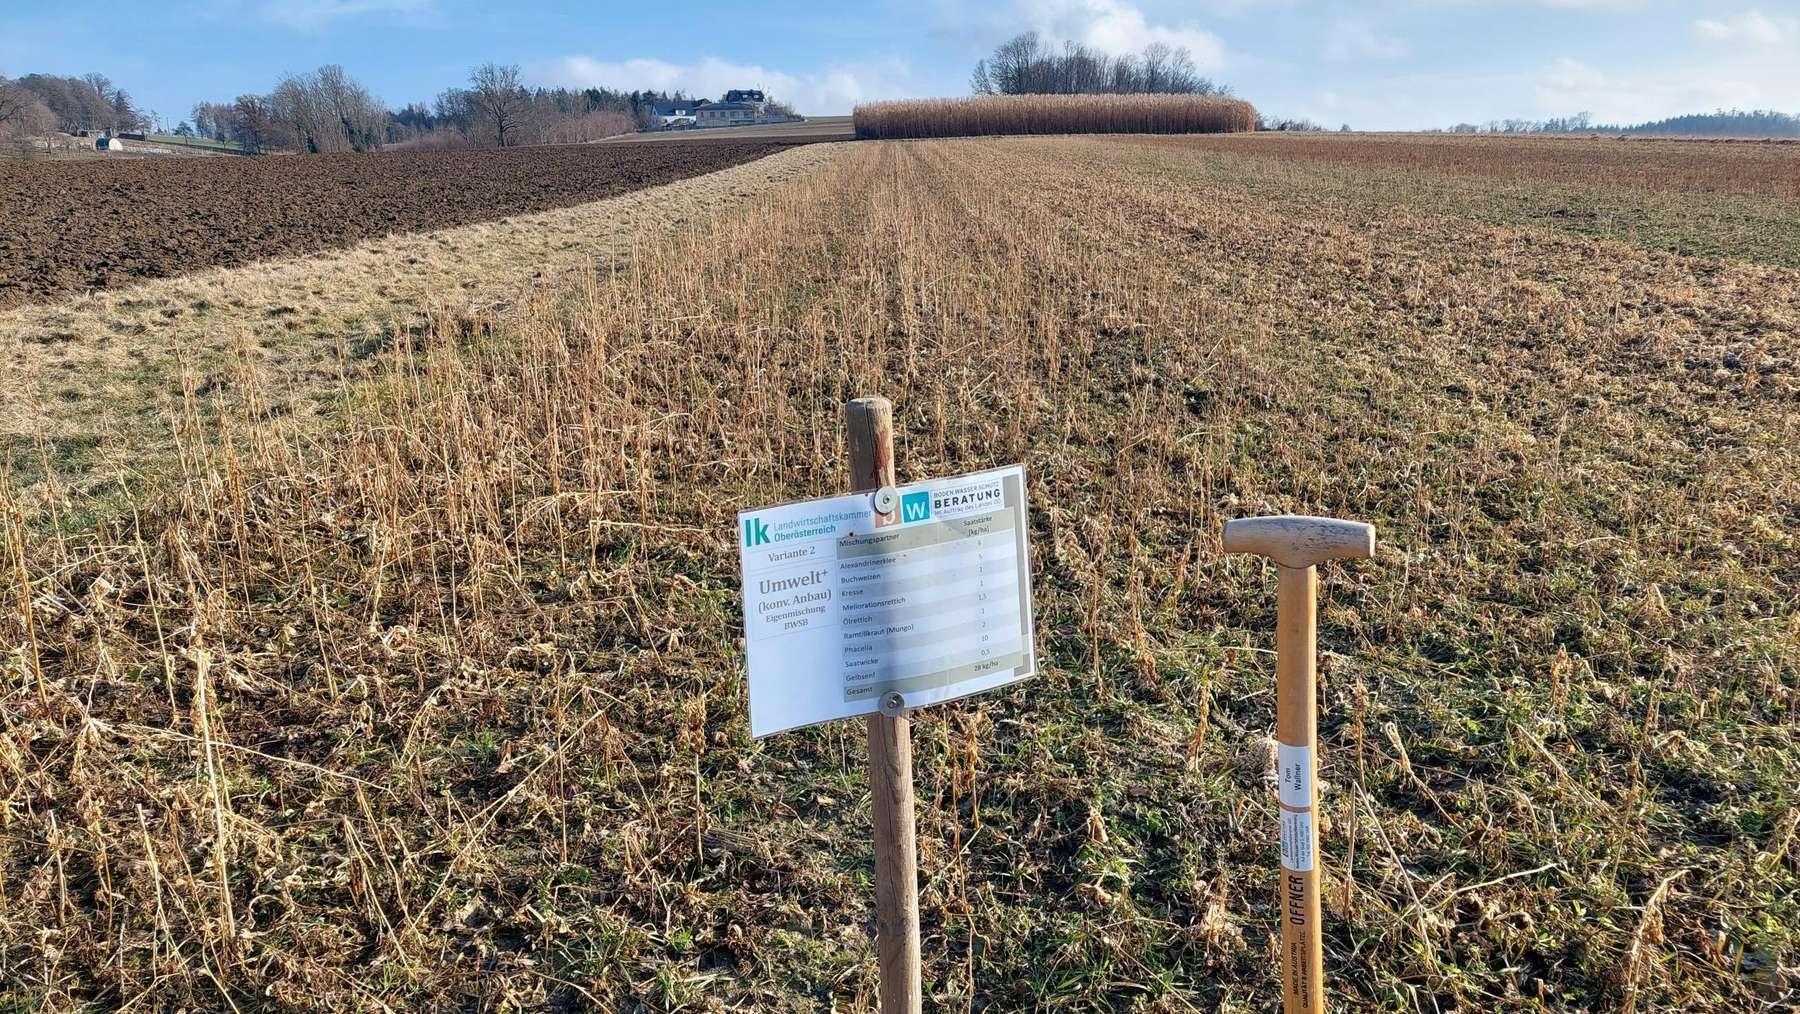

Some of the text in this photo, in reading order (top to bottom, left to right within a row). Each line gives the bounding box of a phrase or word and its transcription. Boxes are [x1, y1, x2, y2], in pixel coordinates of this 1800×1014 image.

[935, 488, 1001, 509] BERATUNG
[905, 501, 926, 521] W
[944, 505, 964, 515] Auftrag
[965, 503, 974, 511] des
[773, 510, 872, 531] Landwirtschaftskammer
[963, 515, 993, 526] Saatstärke
[745, 518, 771, 547] lk
[774, 525, 837, 542] Oberösterreich
[840, 533, 900, 547] Mischungspartner
[768, 546, 816, 562] Variante 2
[840, 557, 897, 570] Alexandrinerklee
[841, 573, 881, 584] Buchweizen
[841, 589, 864, 597] Kresse
[758, 588, 832, 615] (konv. Anbau)
[842, 597, 906, 611] Meliorationsrettich
[766, 605, 826, 623] Eigenmischung
[784, 618, 809, 630] BWSB
[843, 623, 914, 639] Ramtillkraut (Mungo)
[844, 643, 873, 653] Phacelia
[845, 657, 879, 667] Saatwicke
[982, 660, 999, 670] kg/ha
[846, 671, 876, 682] Gelbsenf
[846, 686, 873, 696] Gesamt
[1284, 767, 1292, 783] Tom
[1294, 763, 1302, 791] Wallner
[1288, 875, 1305, 926] OFFNER
[1290, 942, 1298, 969] AUSTRIA
[1301, 981, 1309, 1009] QUALITÄT
